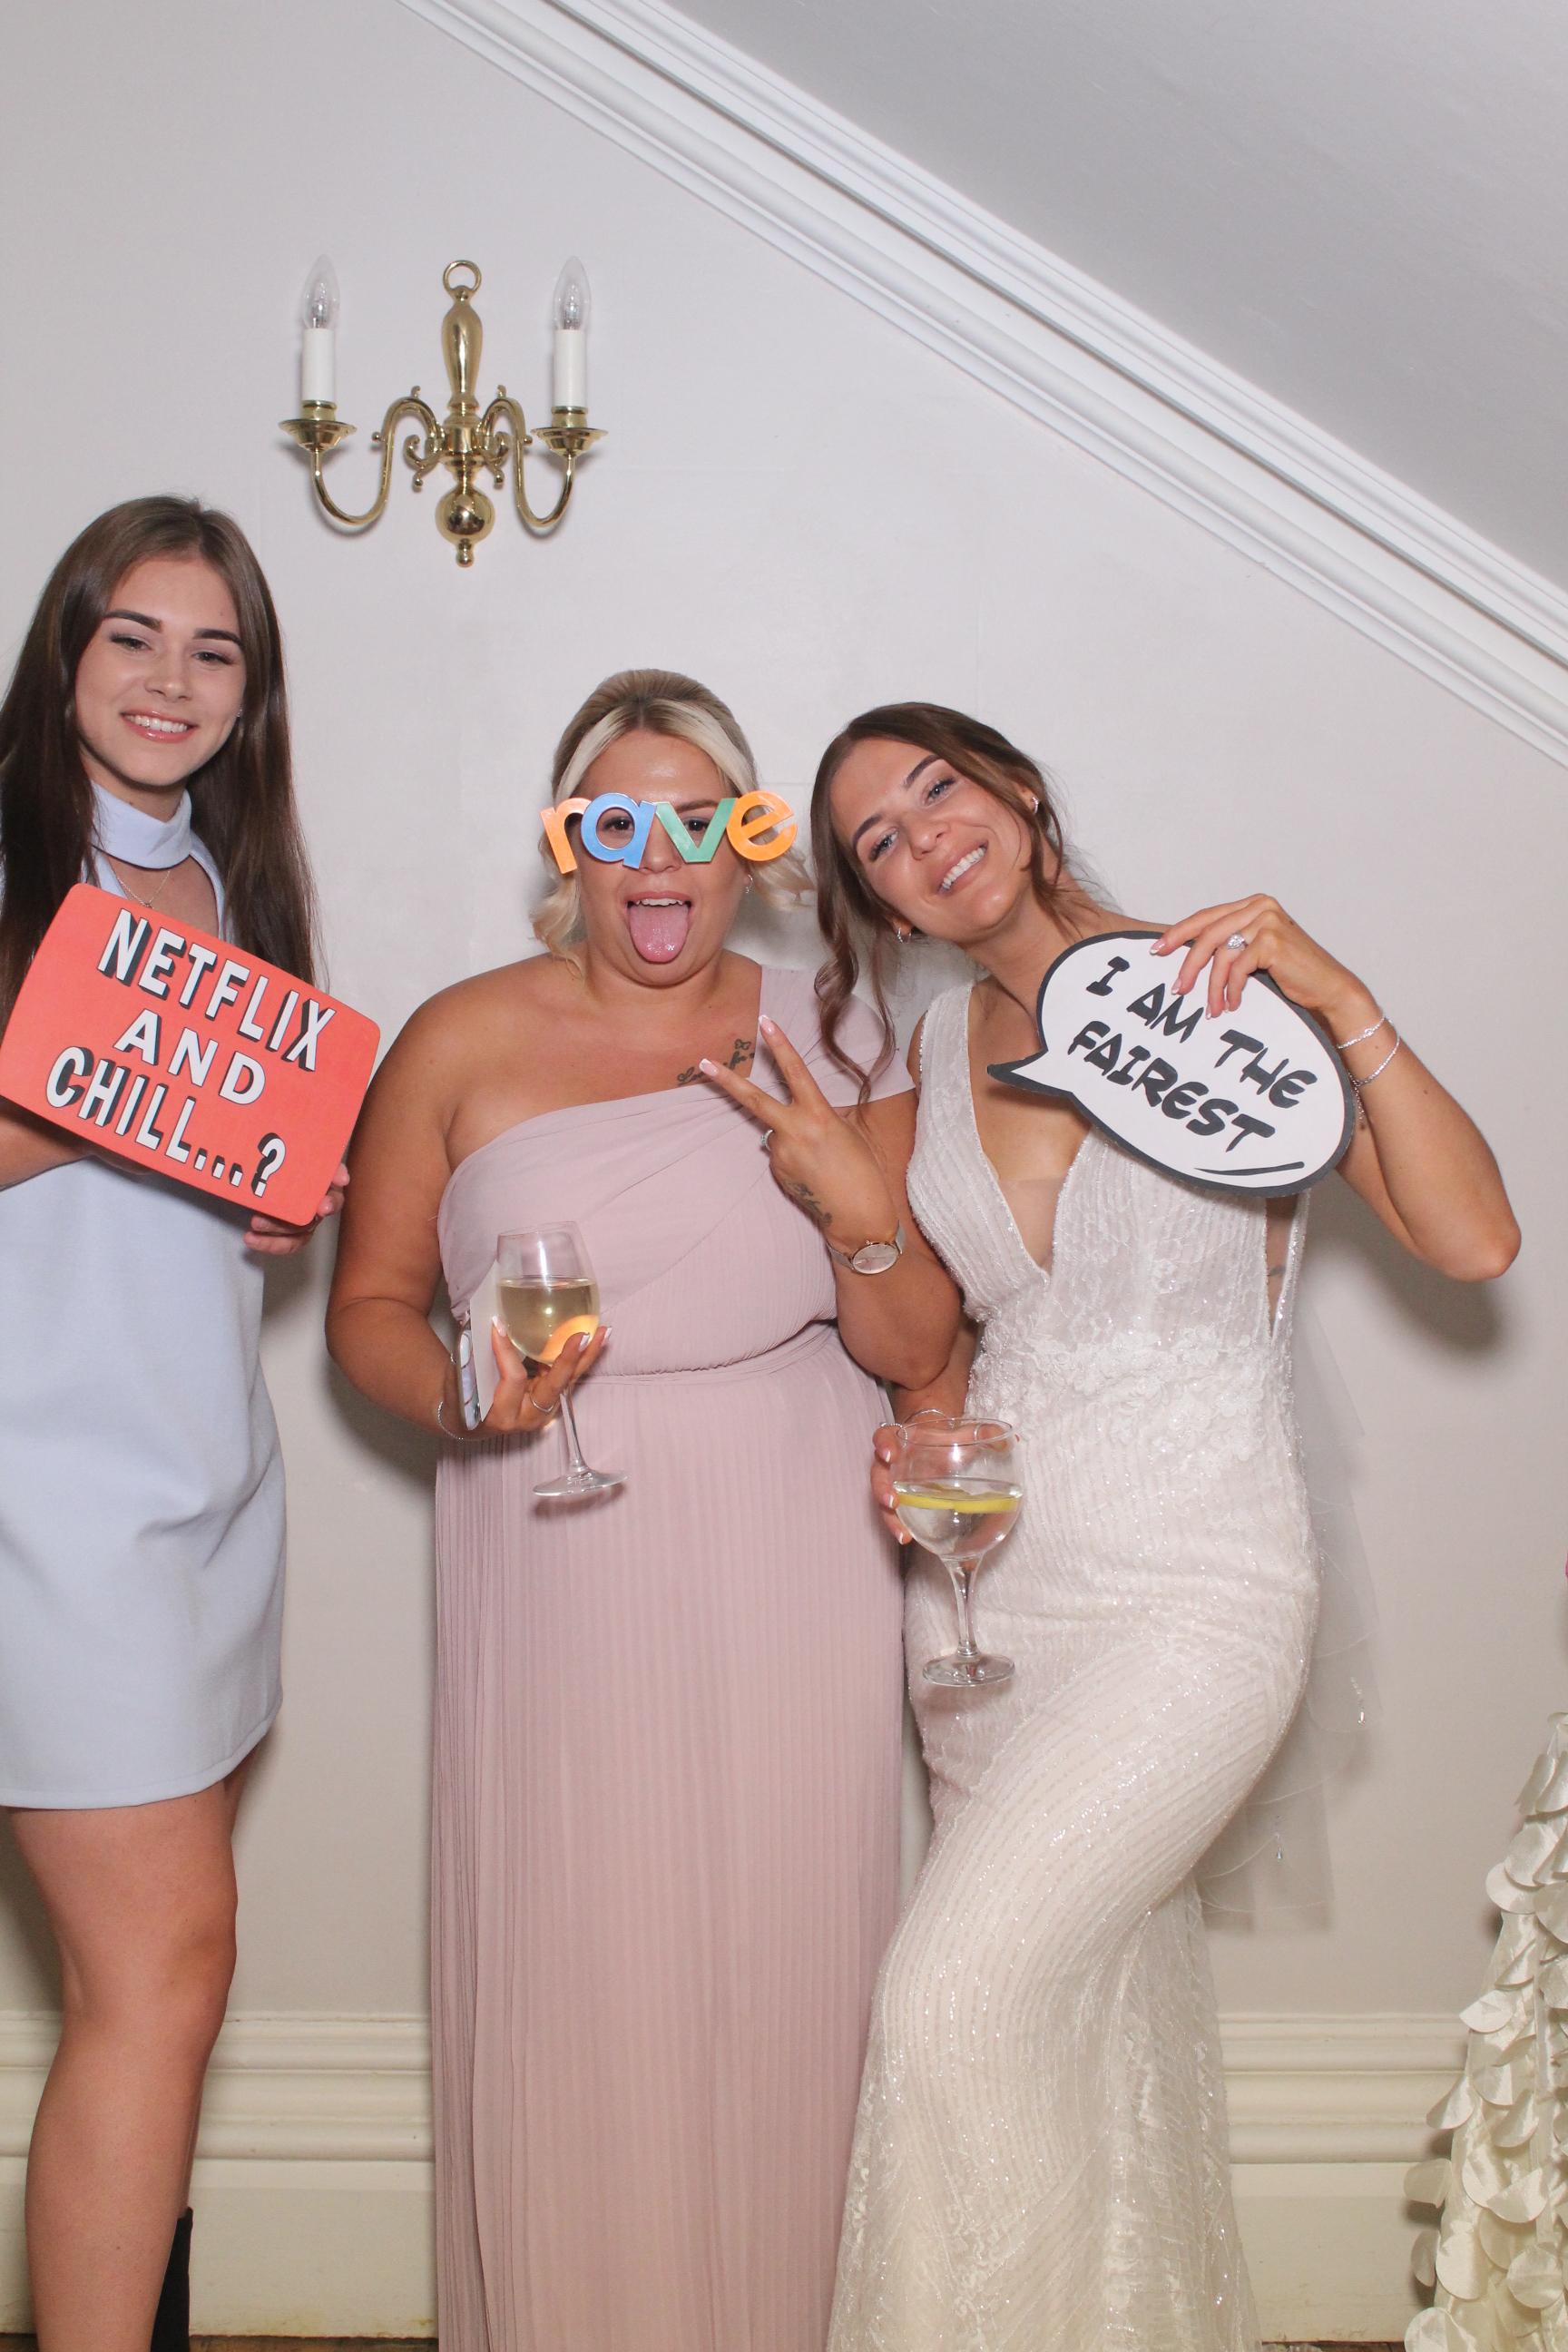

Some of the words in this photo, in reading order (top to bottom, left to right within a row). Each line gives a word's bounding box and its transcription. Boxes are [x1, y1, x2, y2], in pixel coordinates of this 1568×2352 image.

[540, 791, 798, 874] rave
[97, 908, 336, 1072] NETFLIX
[113, 1008, 266, 1104] AND
[1086, 956, 1130, 996] I
[1126, 983, 1205, 1044] AM
[1214, 1028, 1318, 1109] THE
[1067, 1020, 1276, 1152] FAIREST
